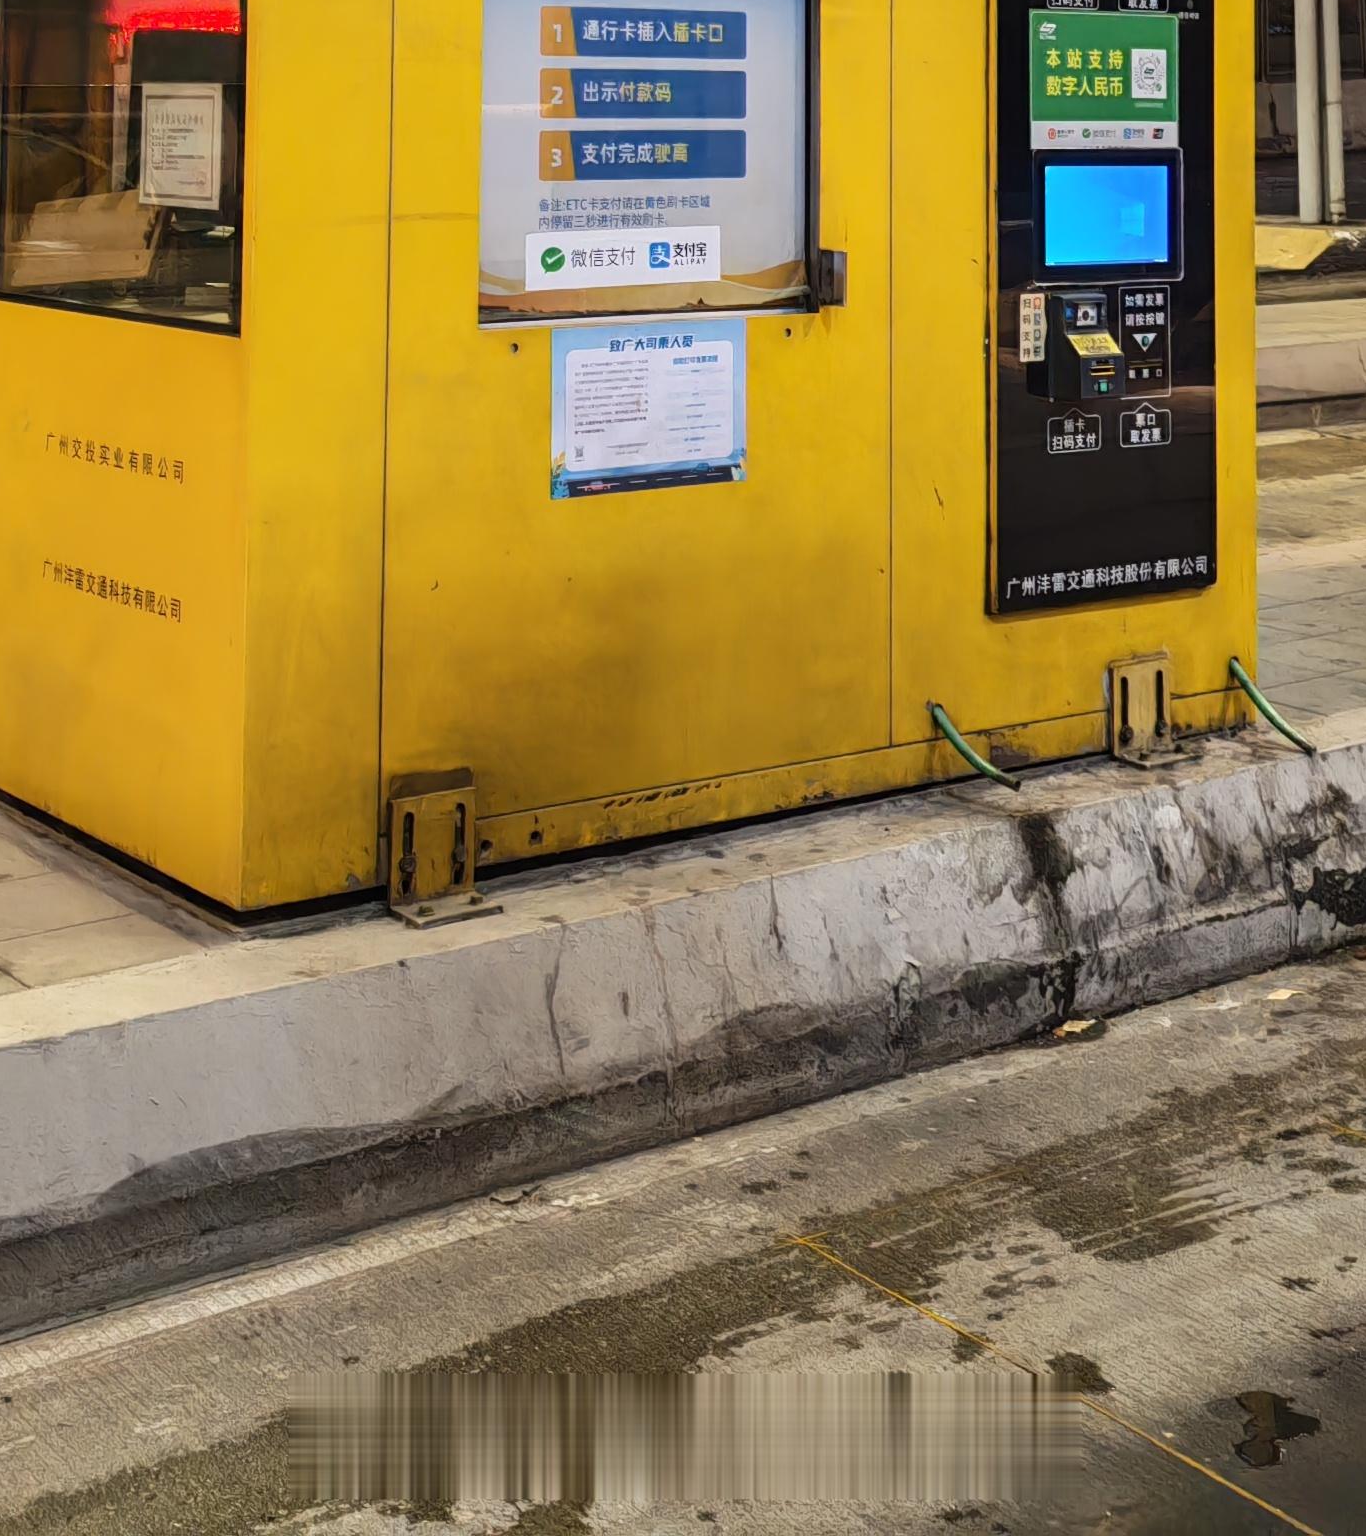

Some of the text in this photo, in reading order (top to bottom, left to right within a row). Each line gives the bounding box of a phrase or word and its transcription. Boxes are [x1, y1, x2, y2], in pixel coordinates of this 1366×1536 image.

[553, 20, 724, 43] 1 通行卡插入插卡口
[1046, 48, 1124, 70] 本站支持
[551, 81, 672, 104] 2 出示付款码
[1046, 76, 1124, 97] 数字人民币
[551, 148, 562, 167] 3
[570, 246, 635, 268] 微信支付
[673, 242, 707, 258] 支付宝
[674, 257, 707, 266] ALIPAY
[1125, 293, 1165, 307] 如需发票
[609, 335, 694, 353] 致广大司乘人员
[1052, 432, 1097, 450] 扫码支付
[1130, 427, 1162, 444] 取发票
[45, 432, 184, 485] 广州交投实业有限公司
[1006, 555, 1208, 600] 广州沣雷交通科技股份有限公司
